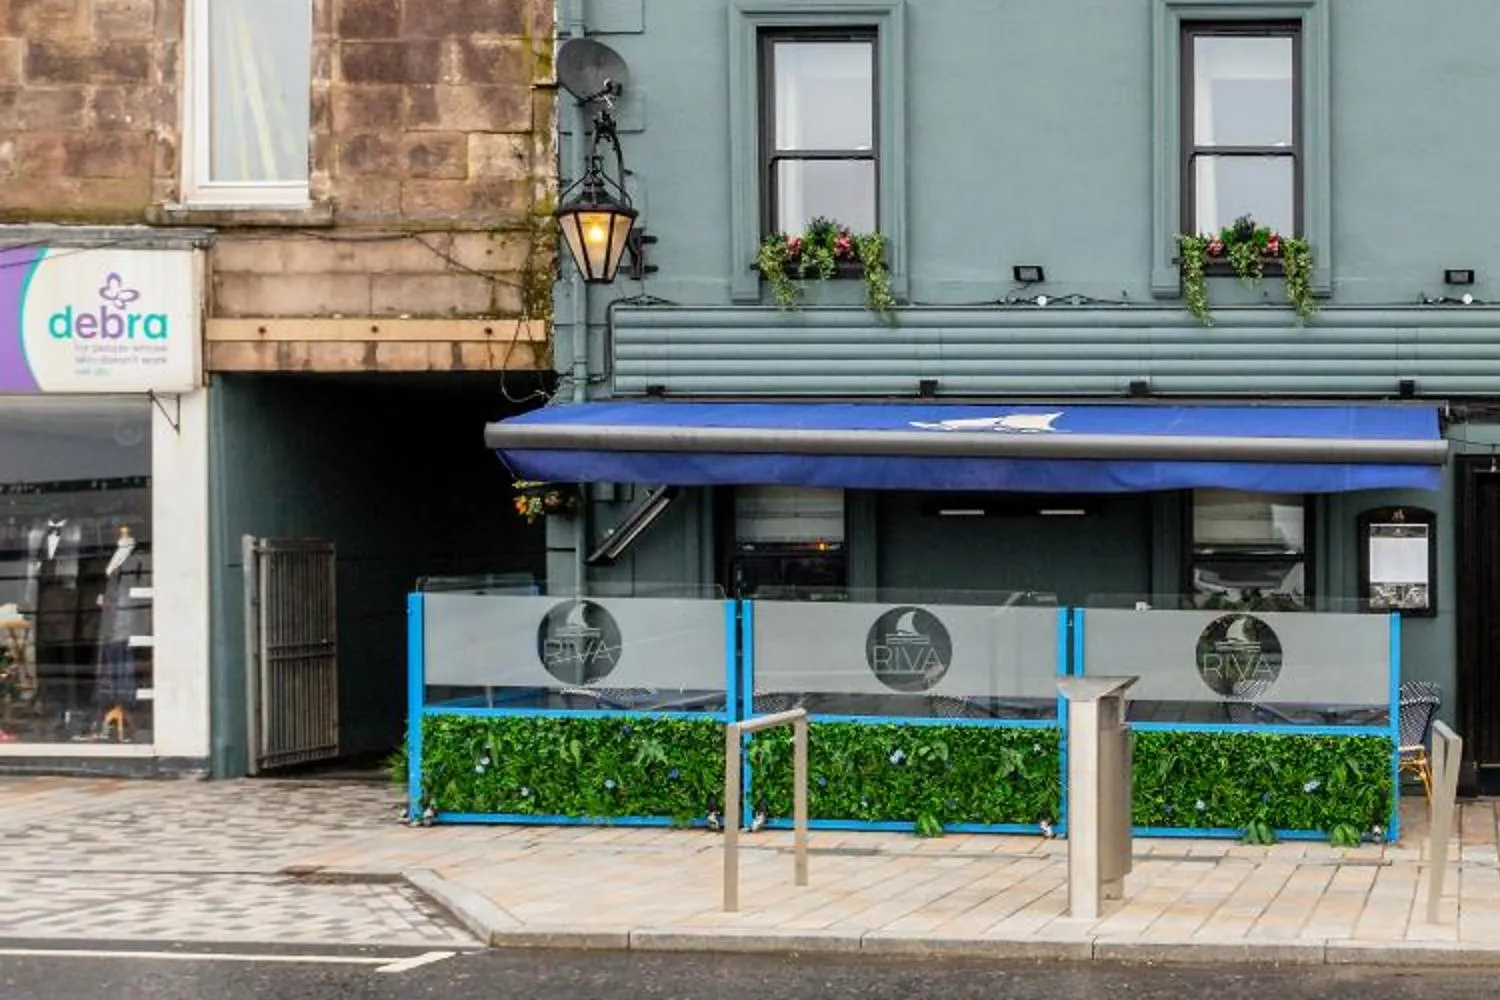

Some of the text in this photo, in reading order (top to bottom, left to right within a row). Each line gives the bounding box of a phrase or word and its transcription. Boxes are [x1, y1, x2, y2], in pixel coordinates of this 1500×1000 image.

[49, 305, 169, 340] debra
[873, 644, 943, 671] RIVA
[1202, 653, 1276, 679] RIVA
